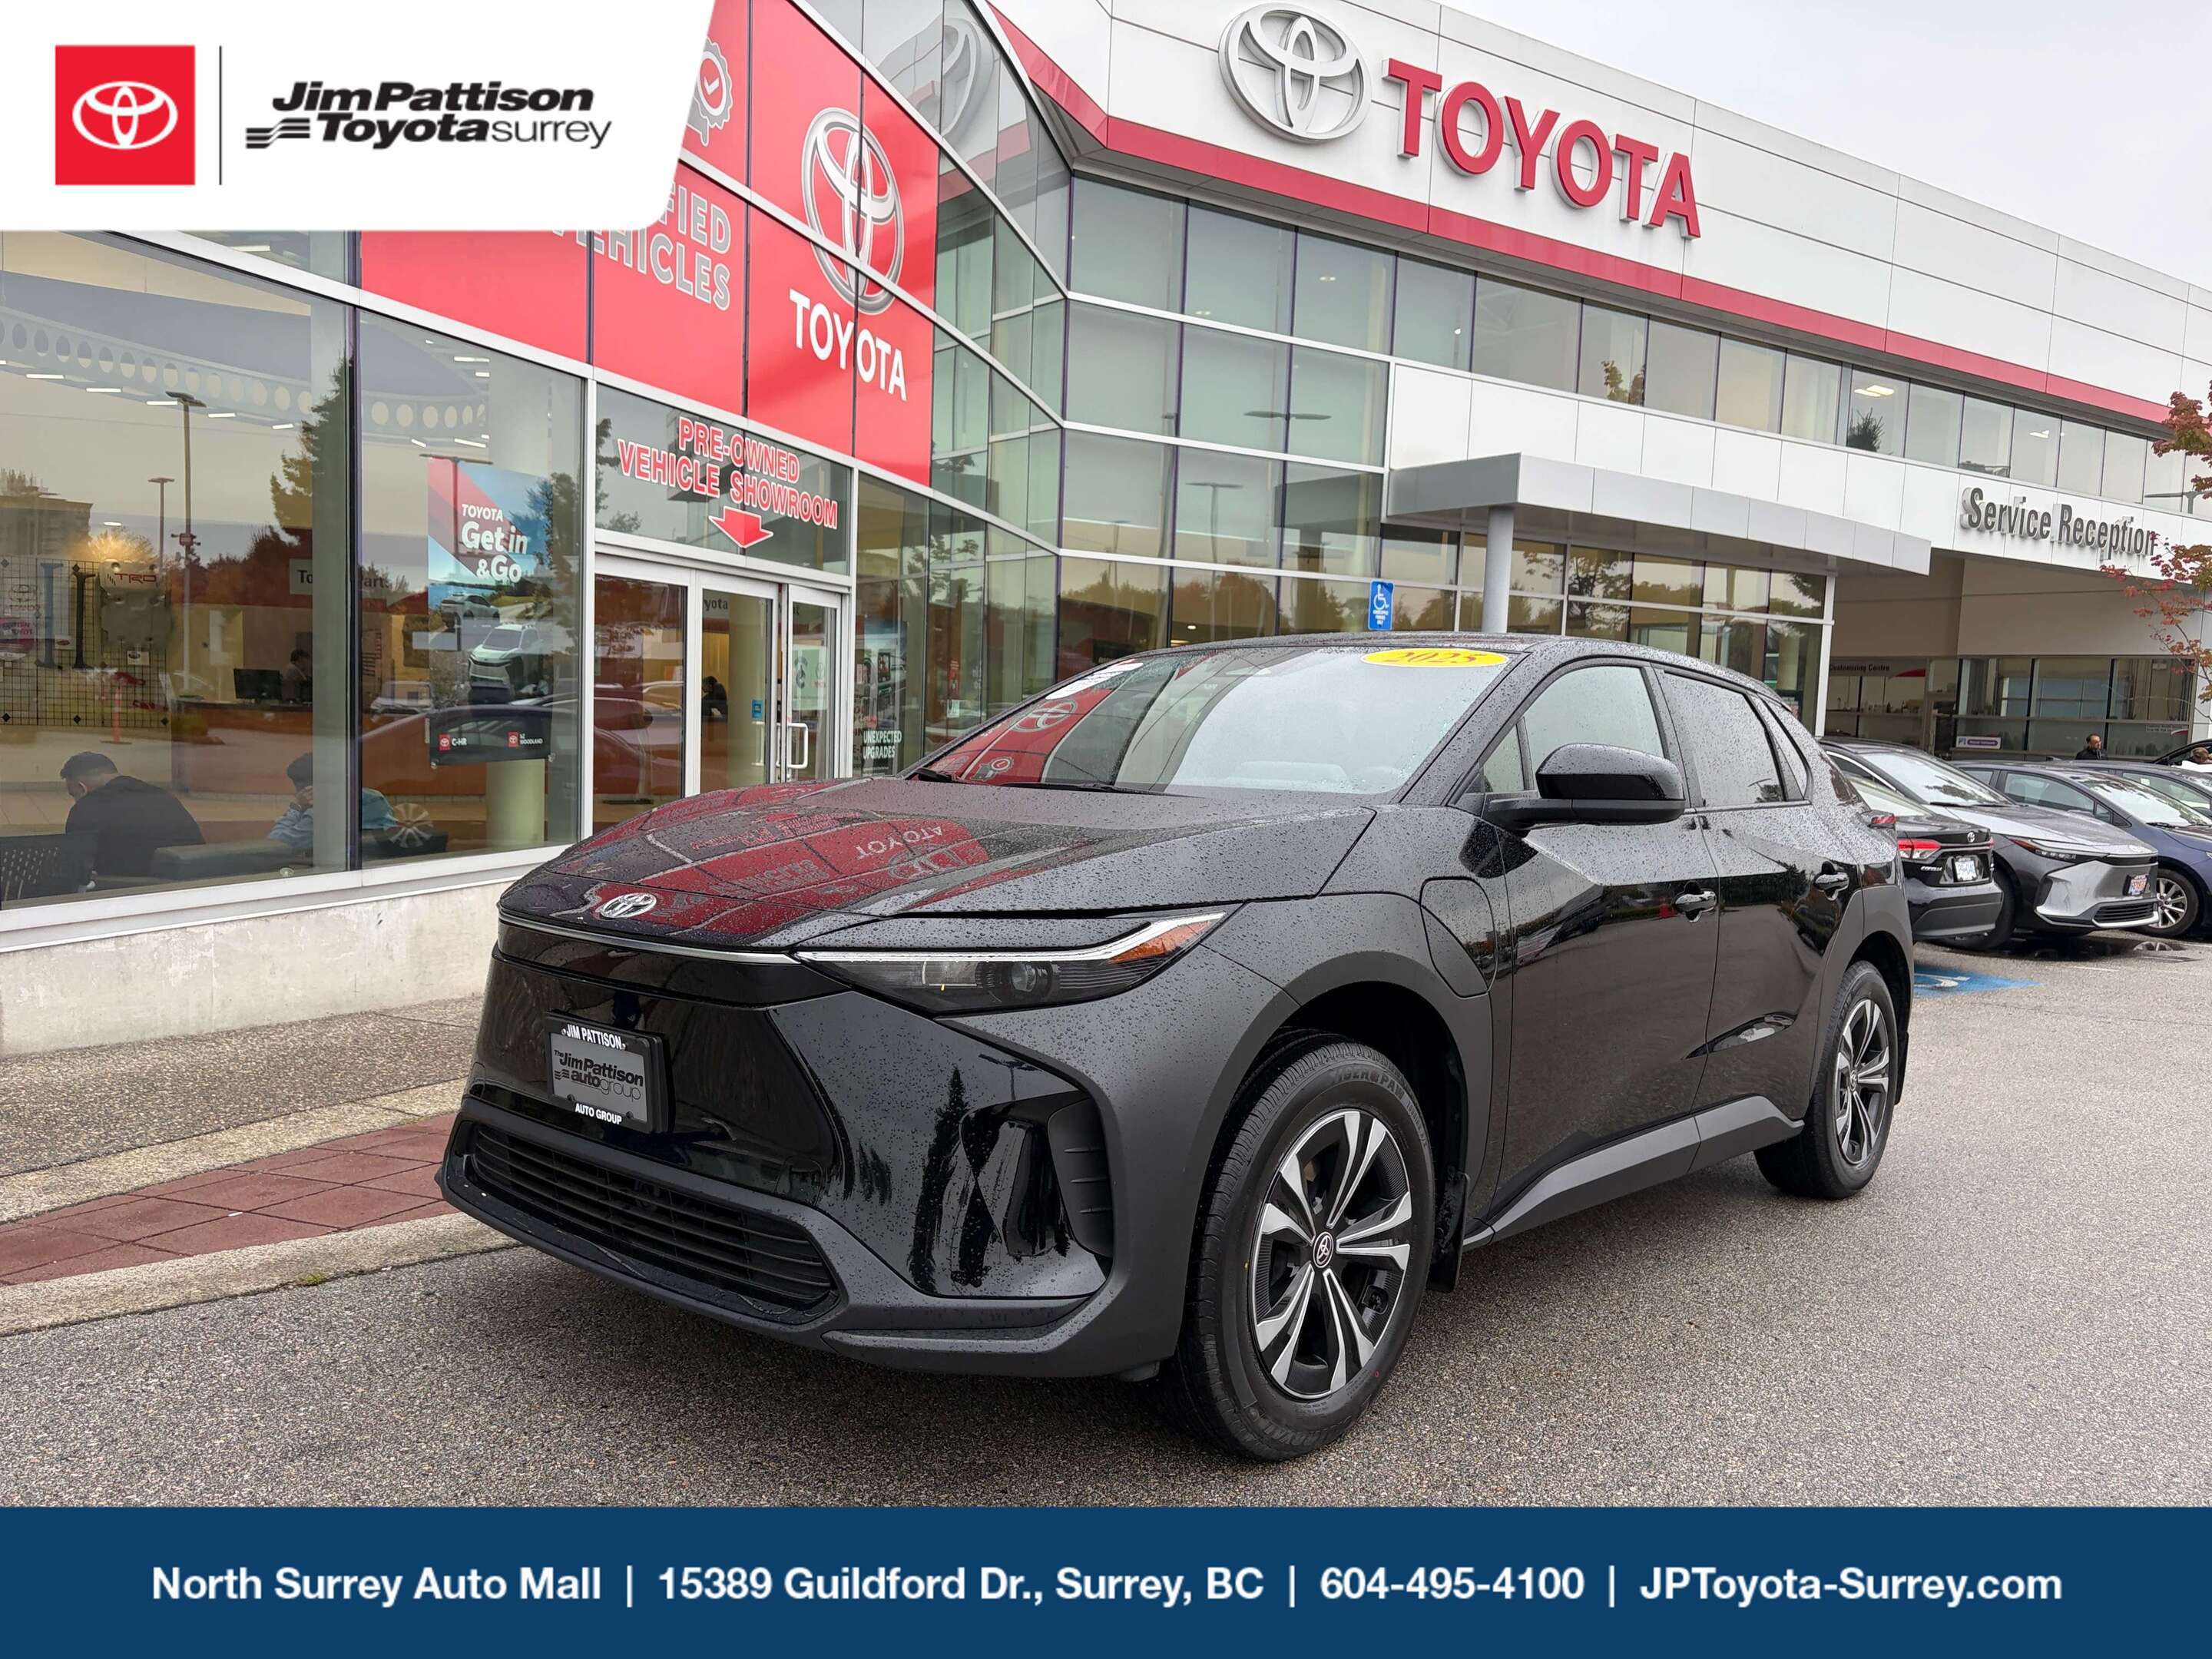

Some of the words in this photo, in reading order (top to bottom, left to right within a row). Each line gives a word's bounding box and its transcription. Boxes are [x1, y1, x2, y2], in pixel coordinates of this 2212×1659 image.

[1382, 58, 1701, 239] TOYOTA
[553, 230, 731, 311] HICLES
[789, 289, 908, 402] TOYOTA
[678, 416, 800, 484] PRE-OWNED
[618, 439, 720, 498] VEHICLE
[730, 470, 837, 529] SHOWROOM
[462, 504, 503, 522] TOYOTA
[1963, 487, 2051, 541] Service
[2057, 503, 2155, 561] Reception
[462, 521, 505, 551] Get
[508, 525, 528, 555] in
[114, 572, 157, 584] TRD
[704, 598, 728, 611] yota
[1382, 652, 1487, 663] 2025
[863, 730, 902, 744] UNEXPECTED
[863, 746, 896, 760] UPGRADES
[566, 1024, 581, 1040] JIM
[581, 1028, 622, 1049] PATTISON
[554, 1049, 565, 1058] The
[575, 1102, 594, 1118] AUTO
[595, 1109, 622, 1125] GROUP
